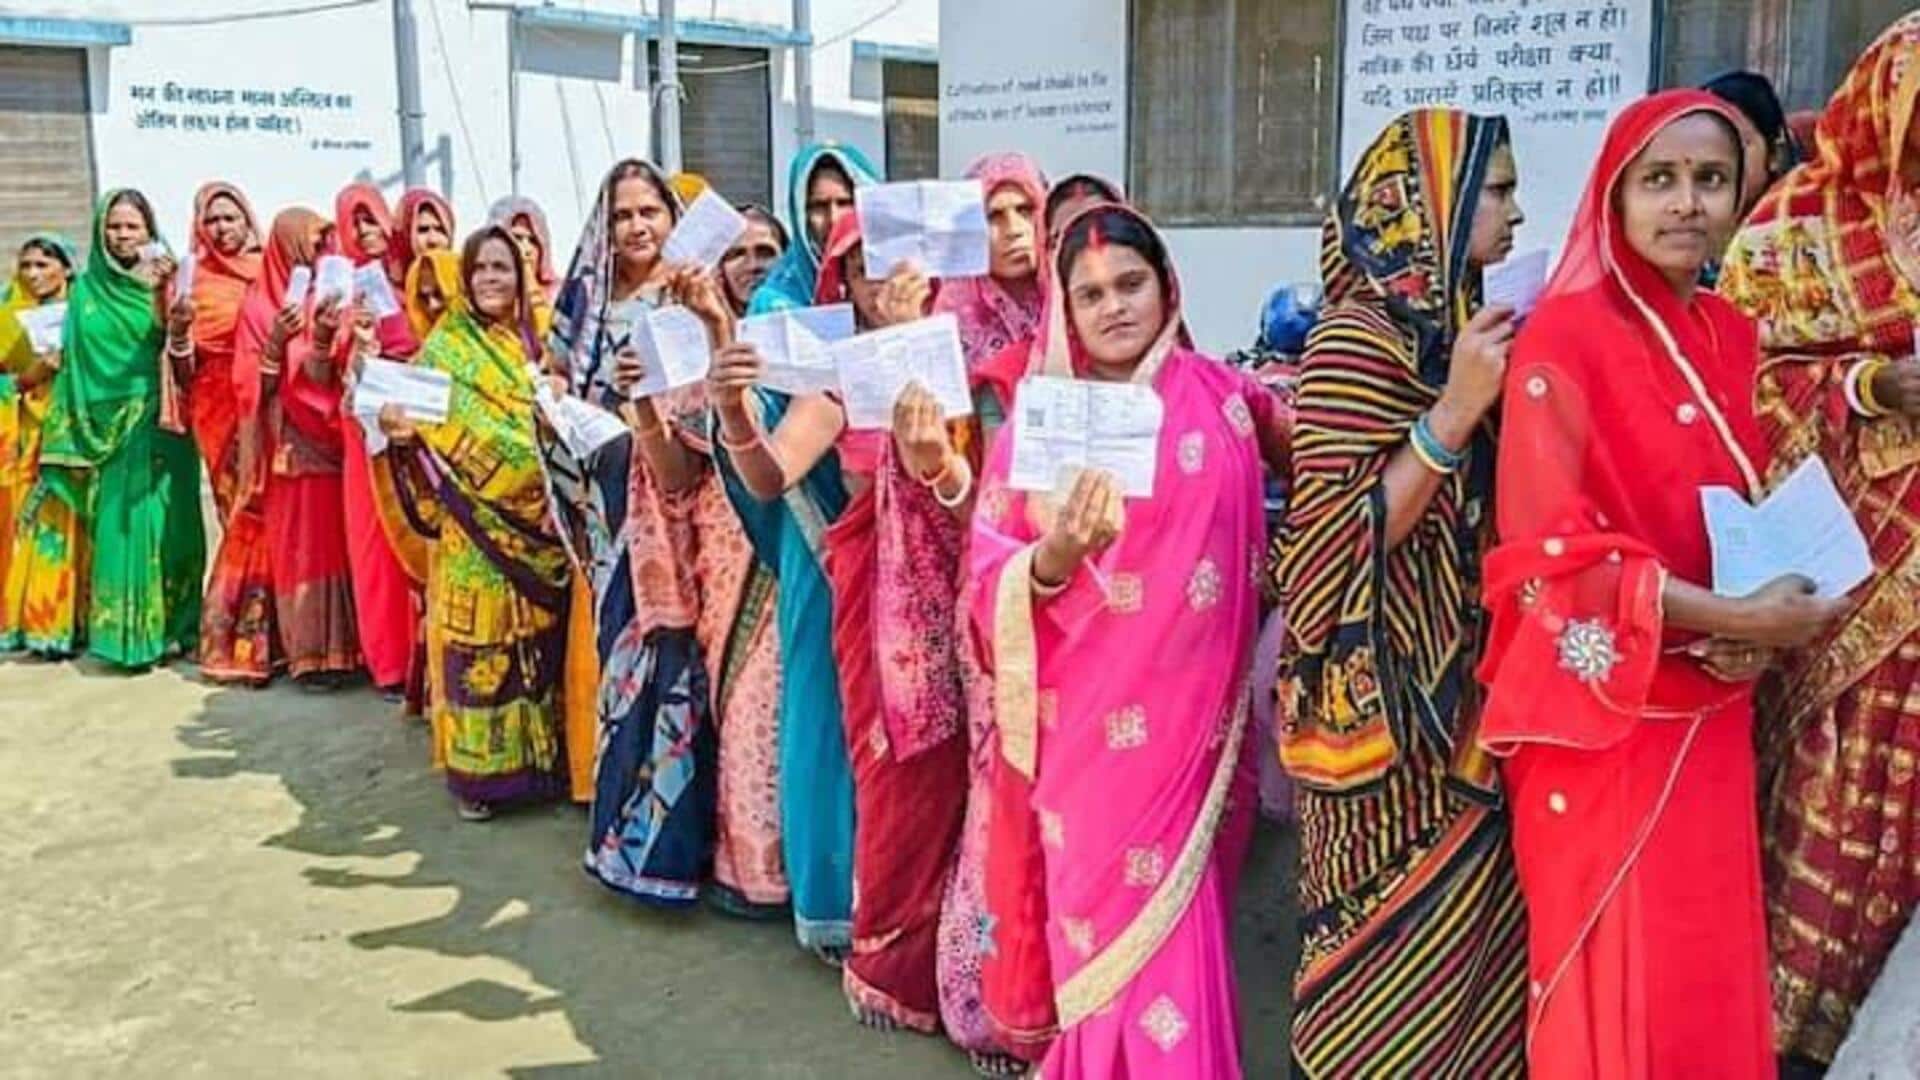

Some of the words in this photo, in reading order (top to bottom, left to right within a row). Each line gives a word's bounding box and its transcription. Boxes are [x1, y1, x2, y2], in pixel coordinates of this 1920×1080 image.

[1530, 12, 1567, 37] शूल
[1575, 9, 1593, 29] न
[1410, 50, 1434, 73] की
[1496, 42, 1551, 68] परीक्षा
[1362, 84, 1391, 107] यदि
[1472, 76, 1543, 105] प्रतिकूल
[1556, 79, 1573, 97] न
